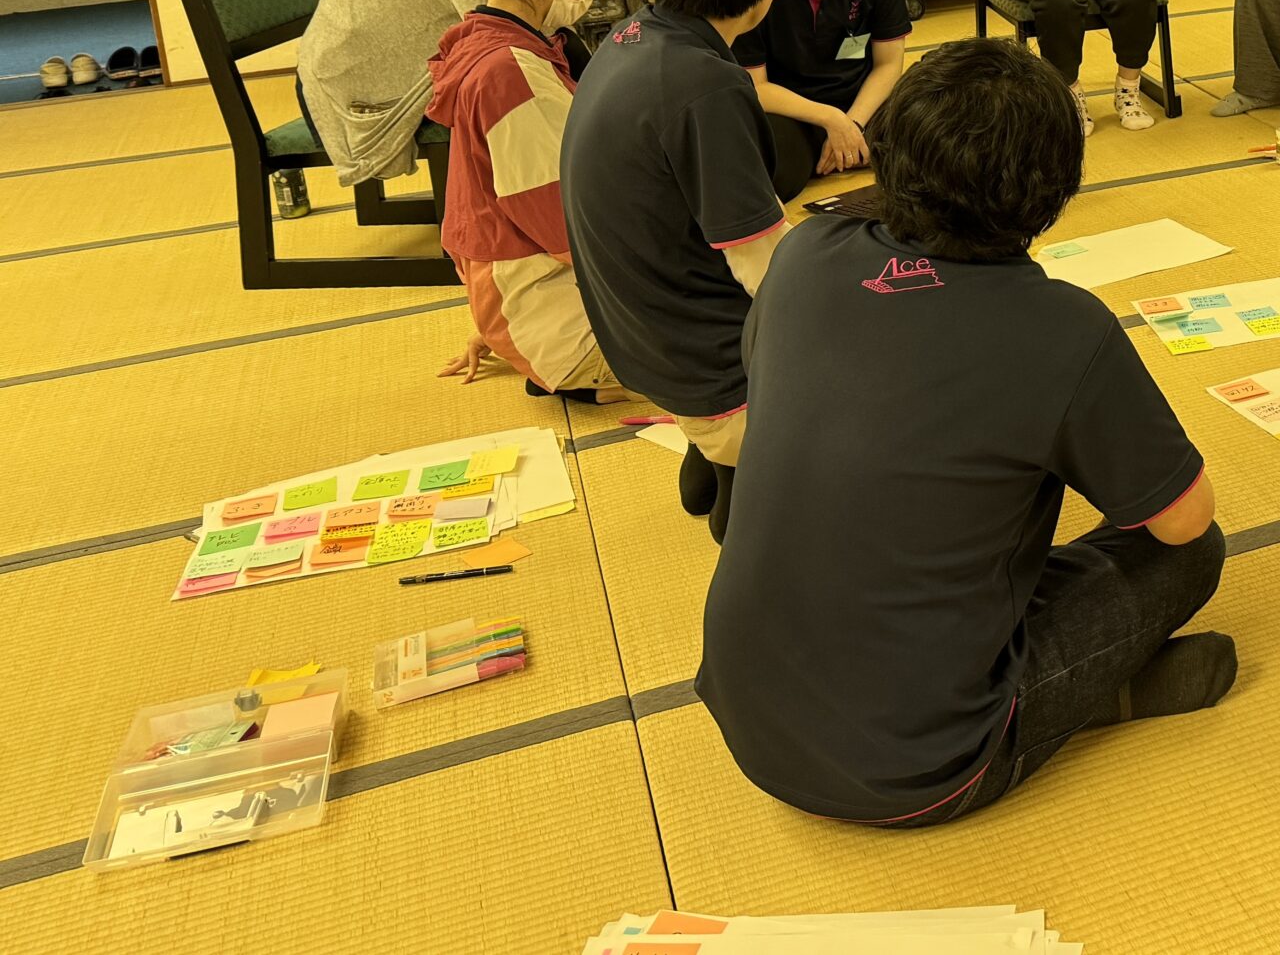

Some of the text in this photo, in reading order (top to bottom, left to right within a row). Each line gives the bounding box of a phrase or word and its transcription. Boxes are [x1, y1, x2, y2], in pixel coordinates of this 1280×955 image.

[875, 257, 937, 285] Ace
[330, 506, 377, 519] エアコン
[383, 691, 395, 703] 24
